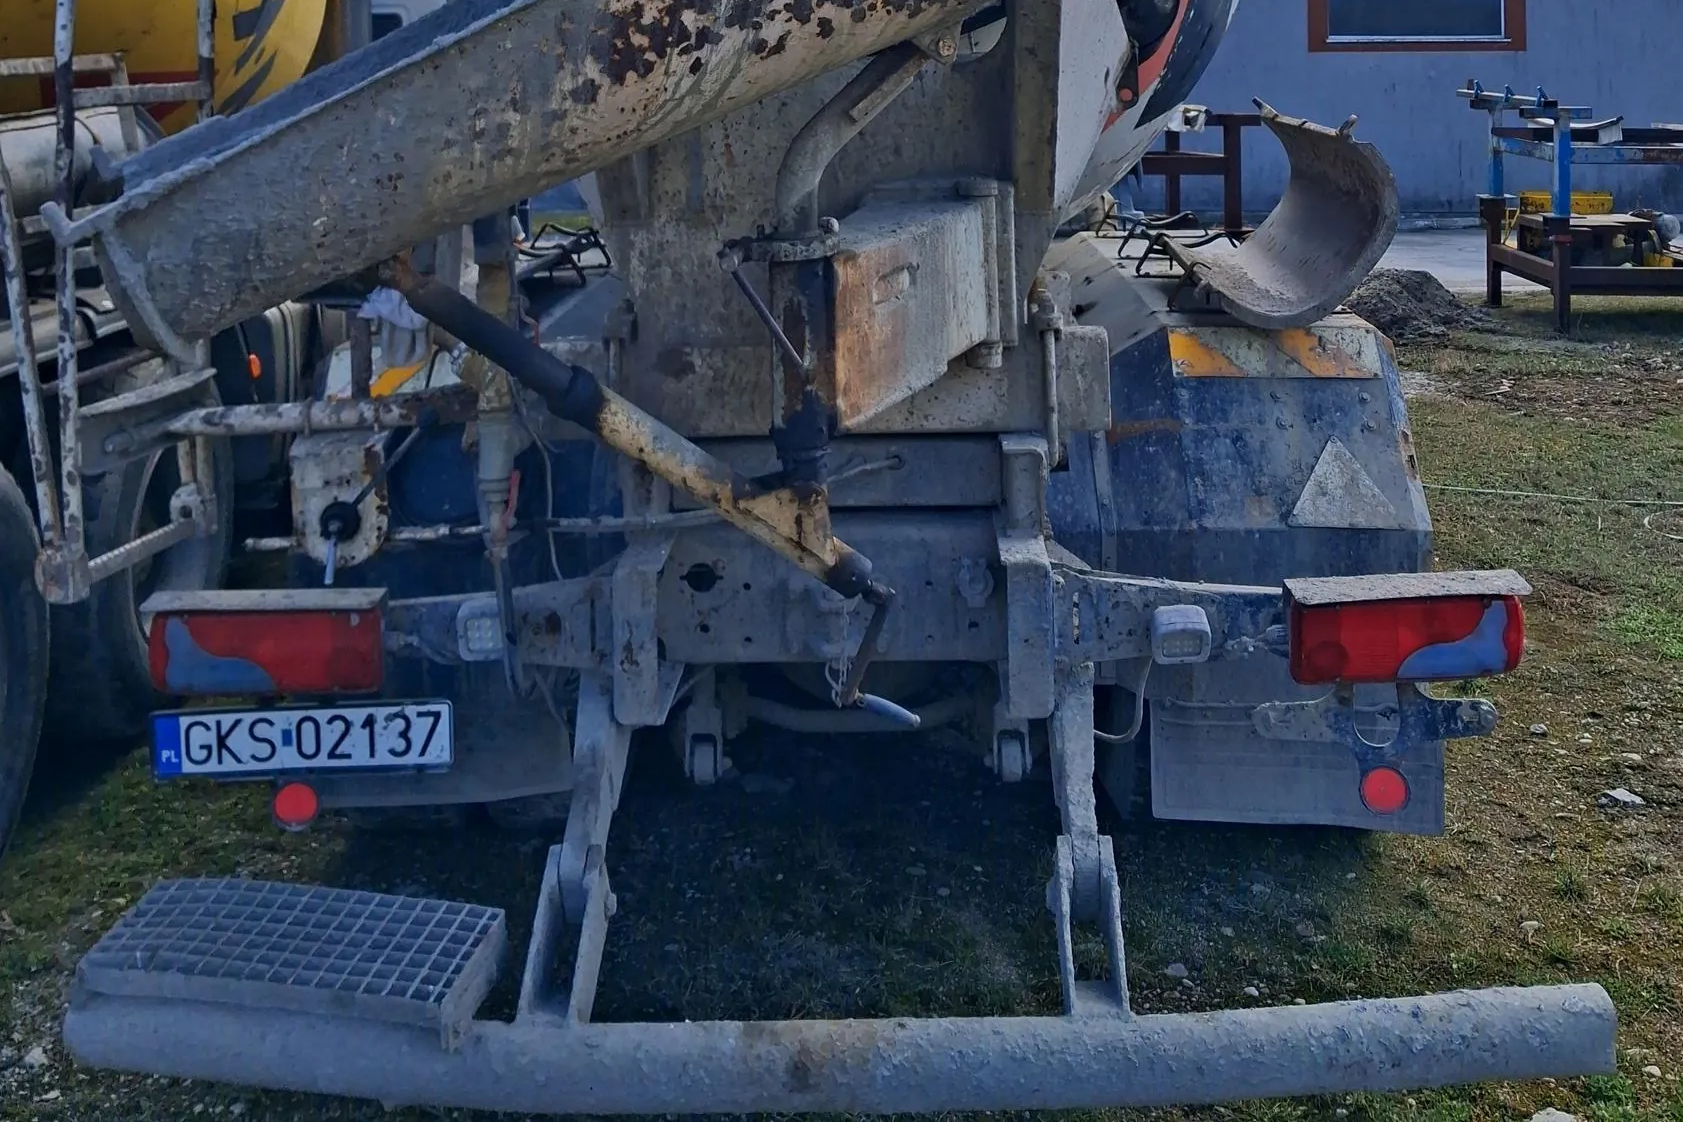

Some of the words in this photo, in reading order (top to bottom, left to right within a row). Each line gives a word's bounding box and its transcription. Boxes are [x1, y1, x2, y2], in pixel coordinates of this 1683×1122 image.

[184, 718, 277, 765] GKS
[295, 711, 442, 760] 02137
[161, 749, 179, 763] PL
